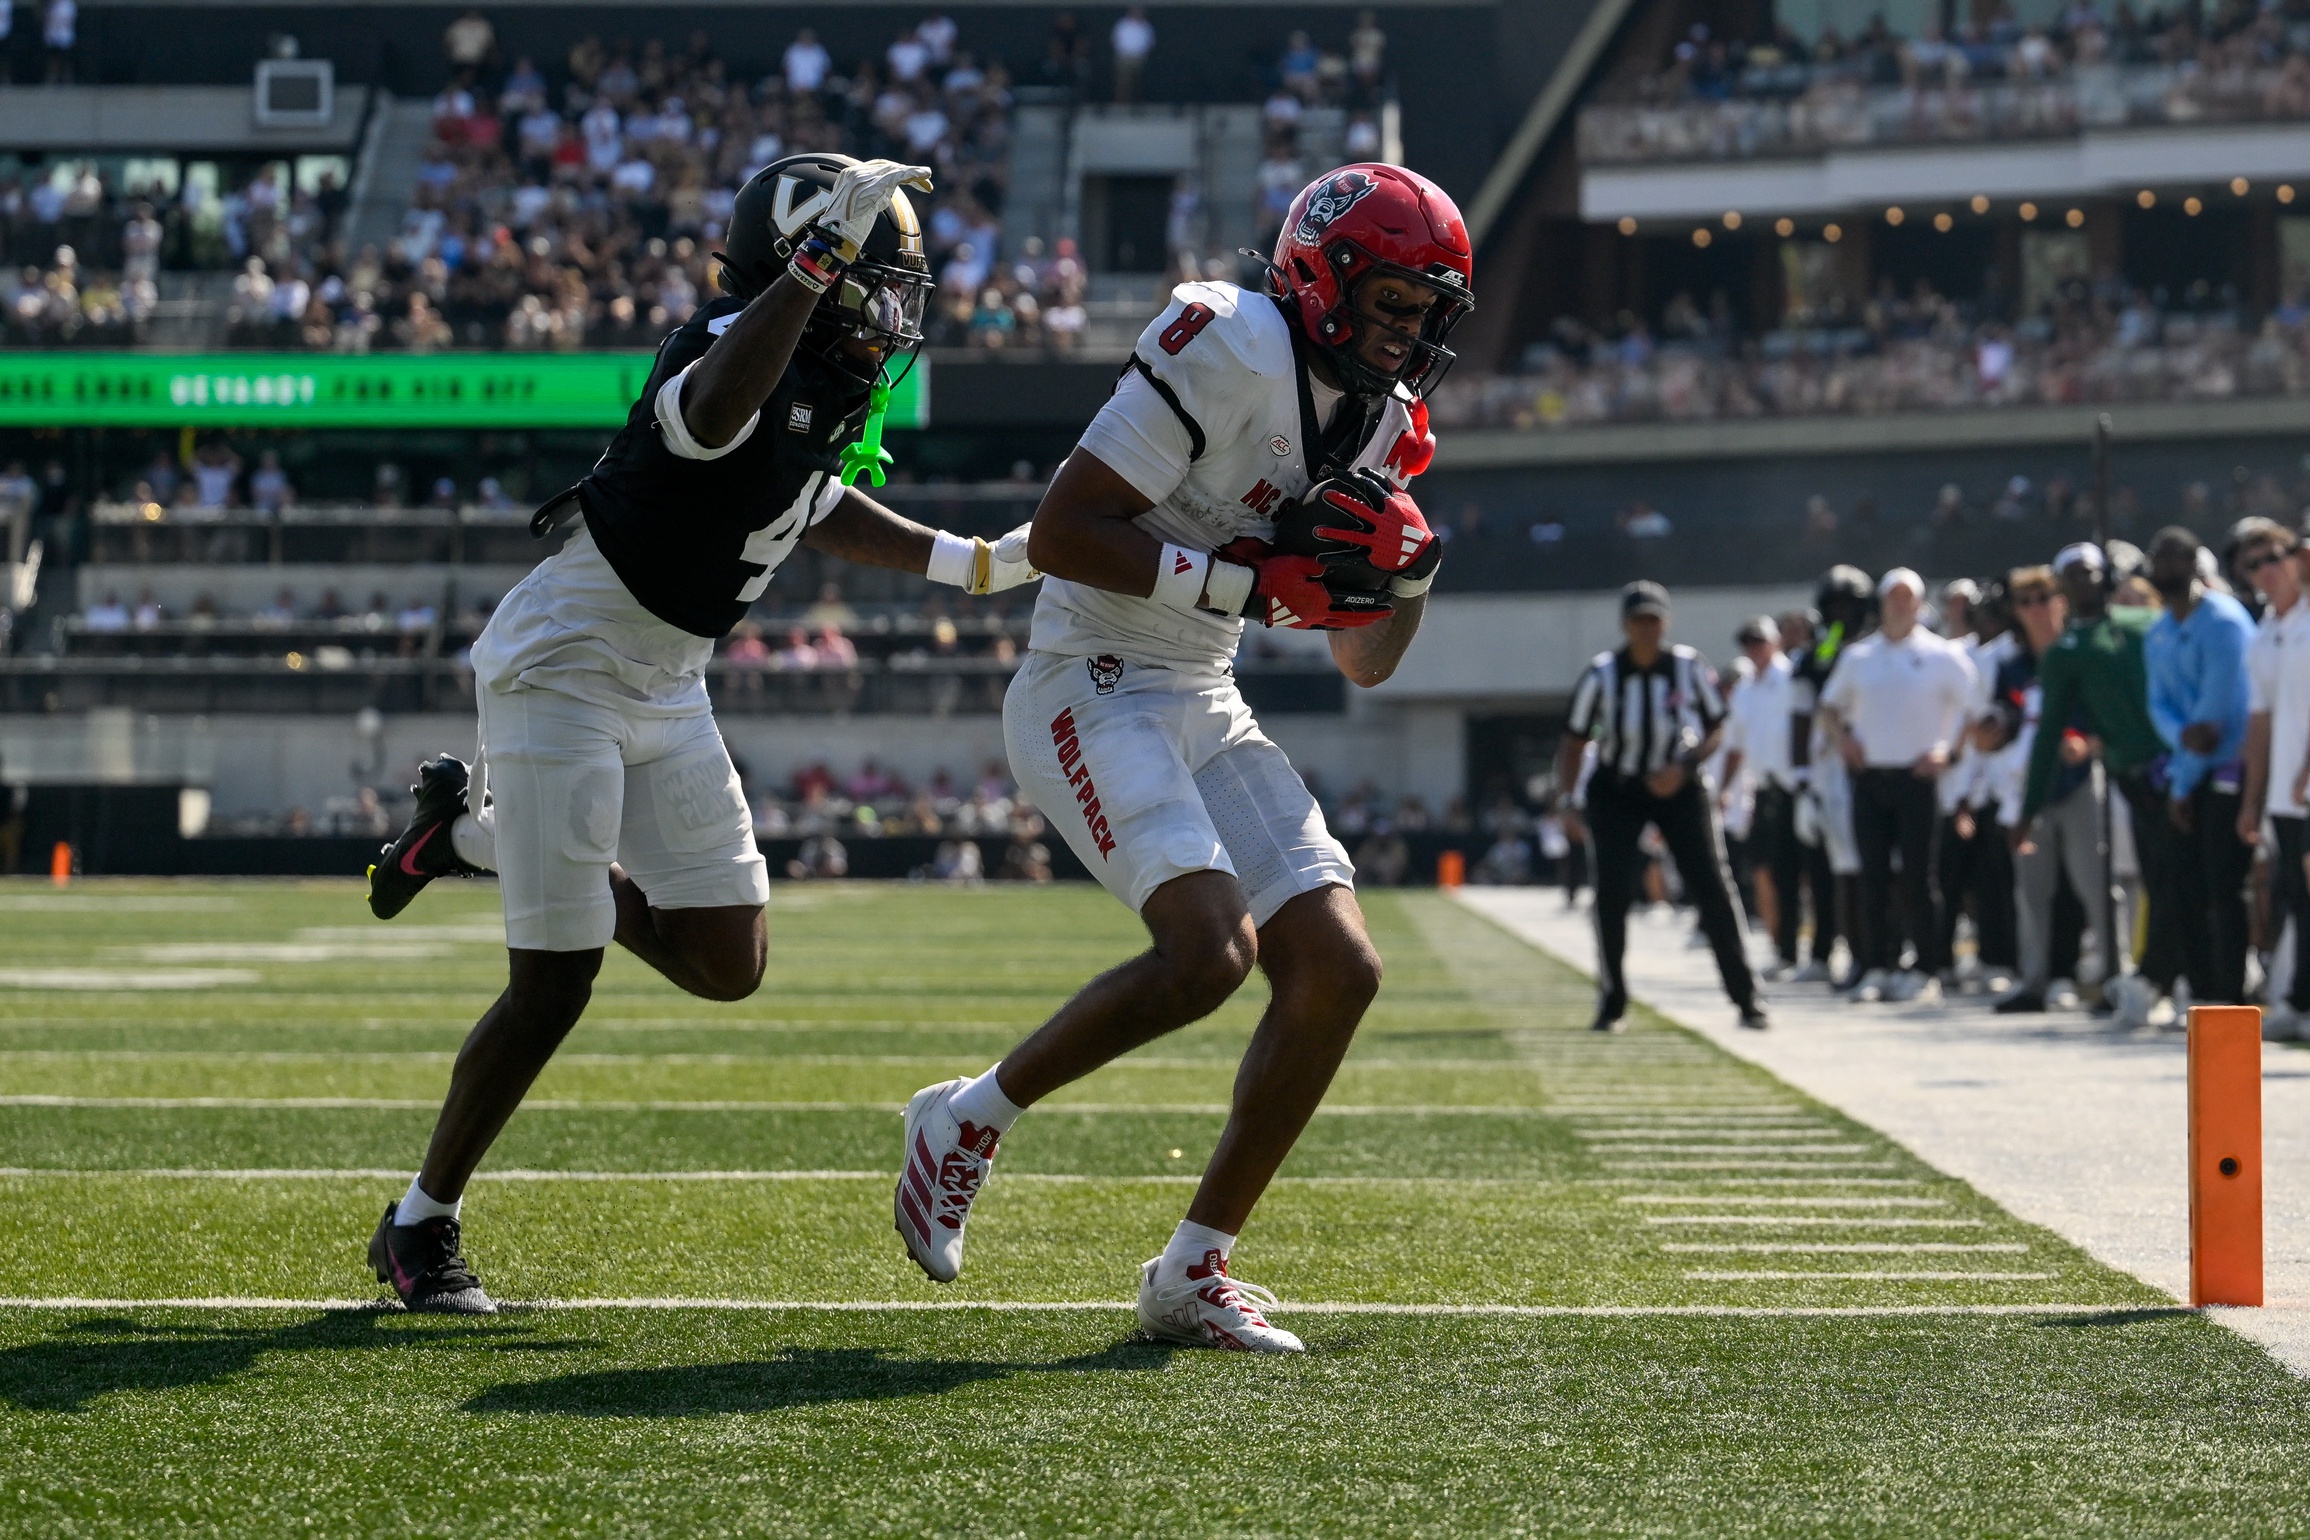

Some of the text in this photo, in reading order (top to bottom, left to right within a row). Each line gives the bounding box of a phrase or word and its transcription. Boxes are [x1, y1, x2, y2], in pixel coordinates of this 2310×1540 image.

[772, 175, 832, 238] V
[1442, 270, 1465, 284] ACC
[1158, 301, 1216, 356] 8
[1273, 439, 1289, 452] ACC
[1239, 477, 1282, 515] NC
[735, 470, 824, 603] 4
[1344, 595, 1375, 605] ADIZERO
[1050, 706, 1117, 864] WOLFPACK
